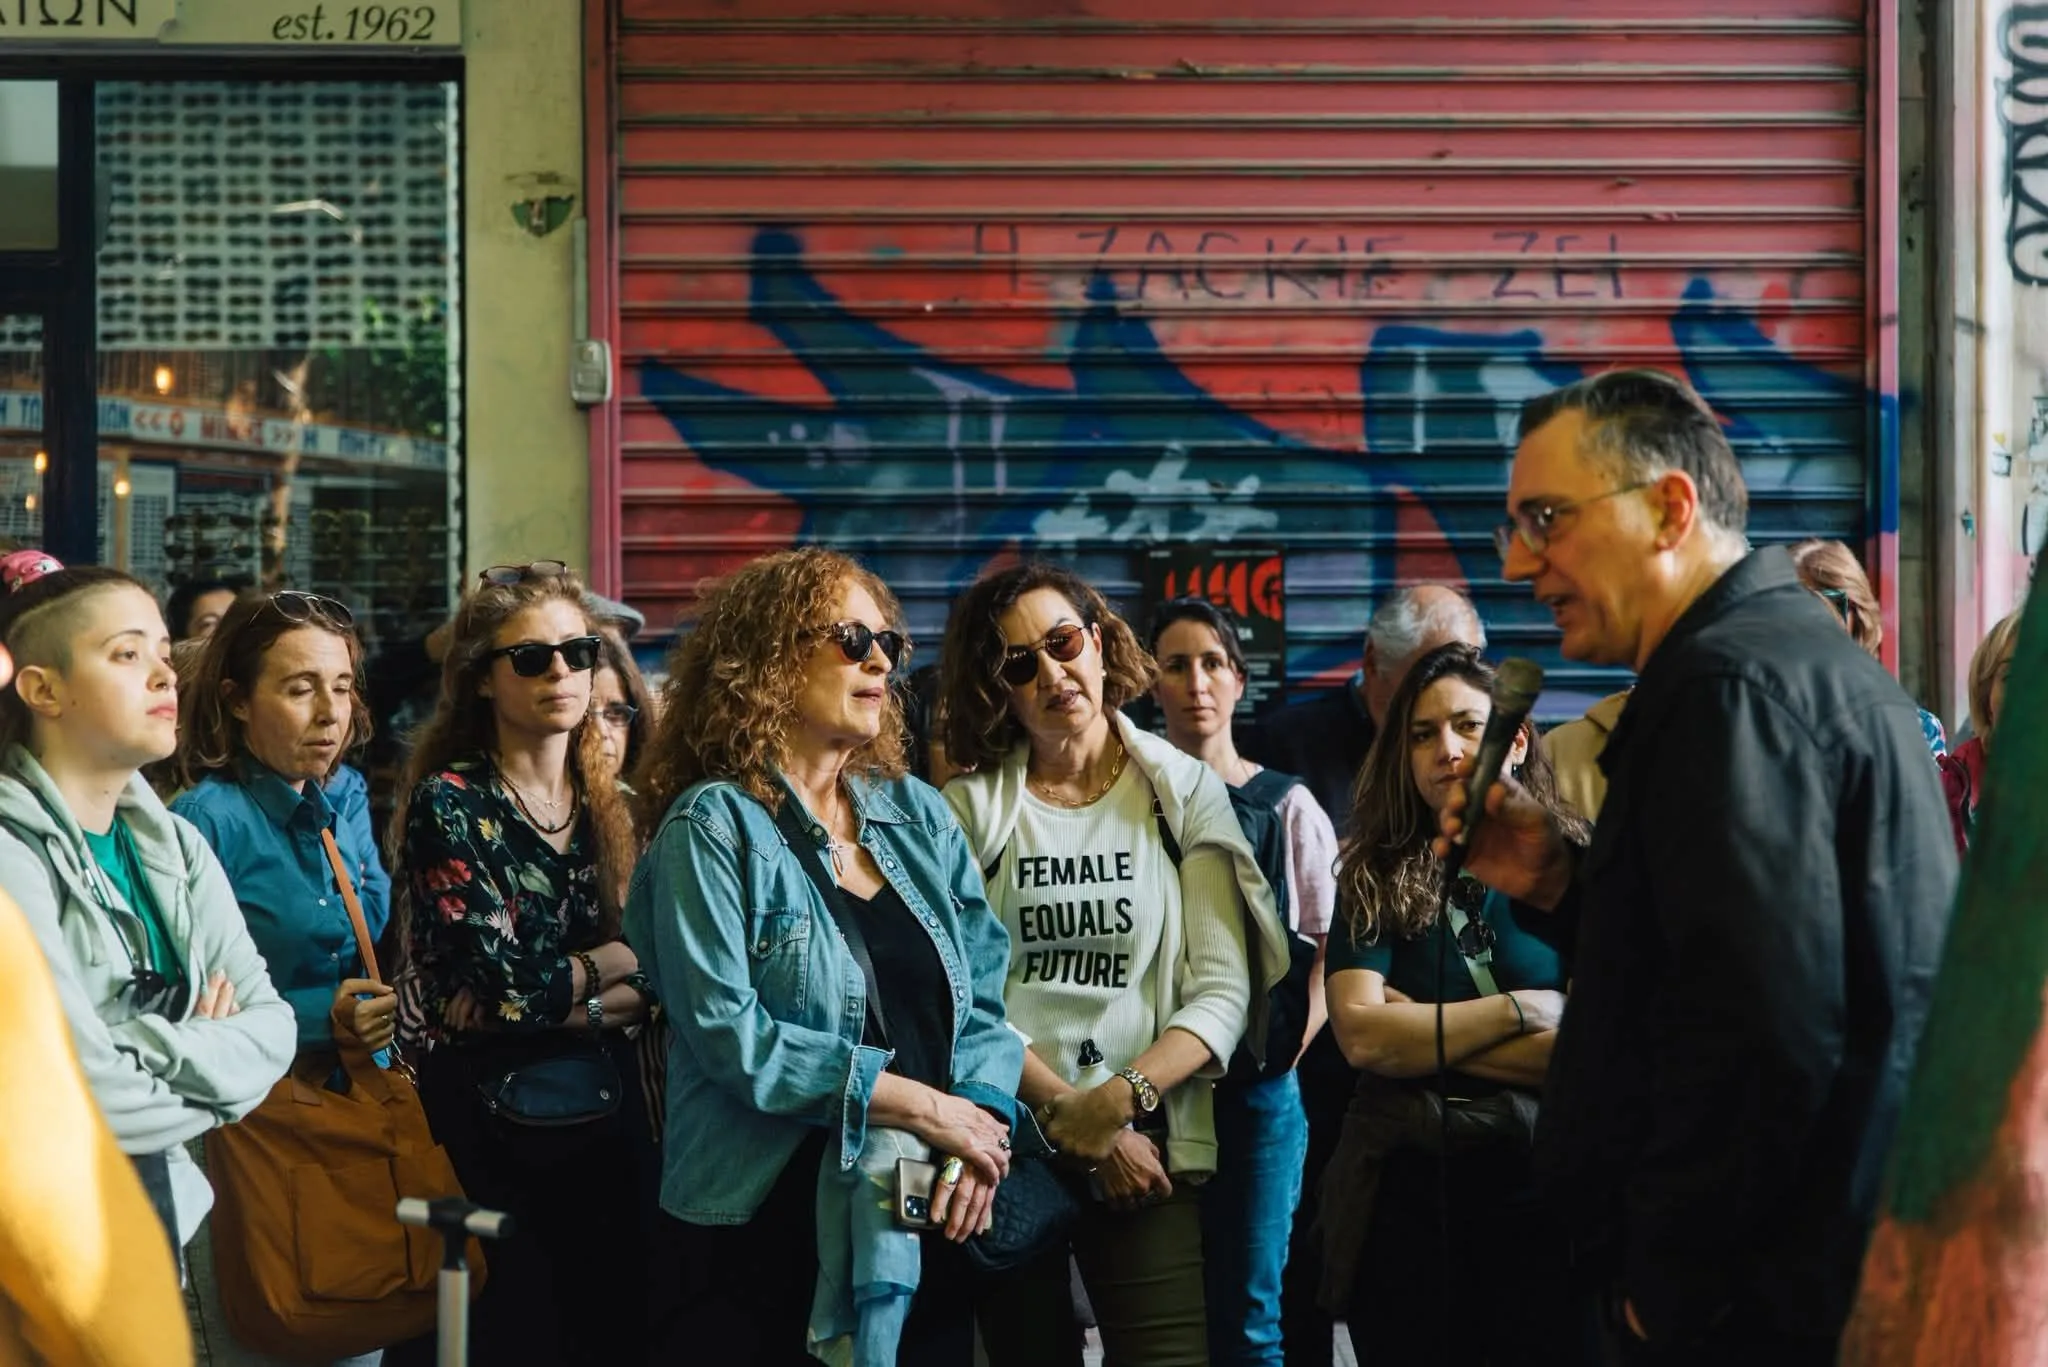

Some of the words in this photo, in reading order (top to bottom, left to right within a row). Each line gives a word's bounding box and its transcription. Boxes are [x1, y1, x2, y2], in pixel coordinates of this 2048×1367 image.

[0, 0, 137, 27] ΙΩΝ
[1018, 852, 1133, 889] FEMALE
[1019, 897, 1133, 943] EQUALS
[1022, 949, 1130, 989] FUTURE
